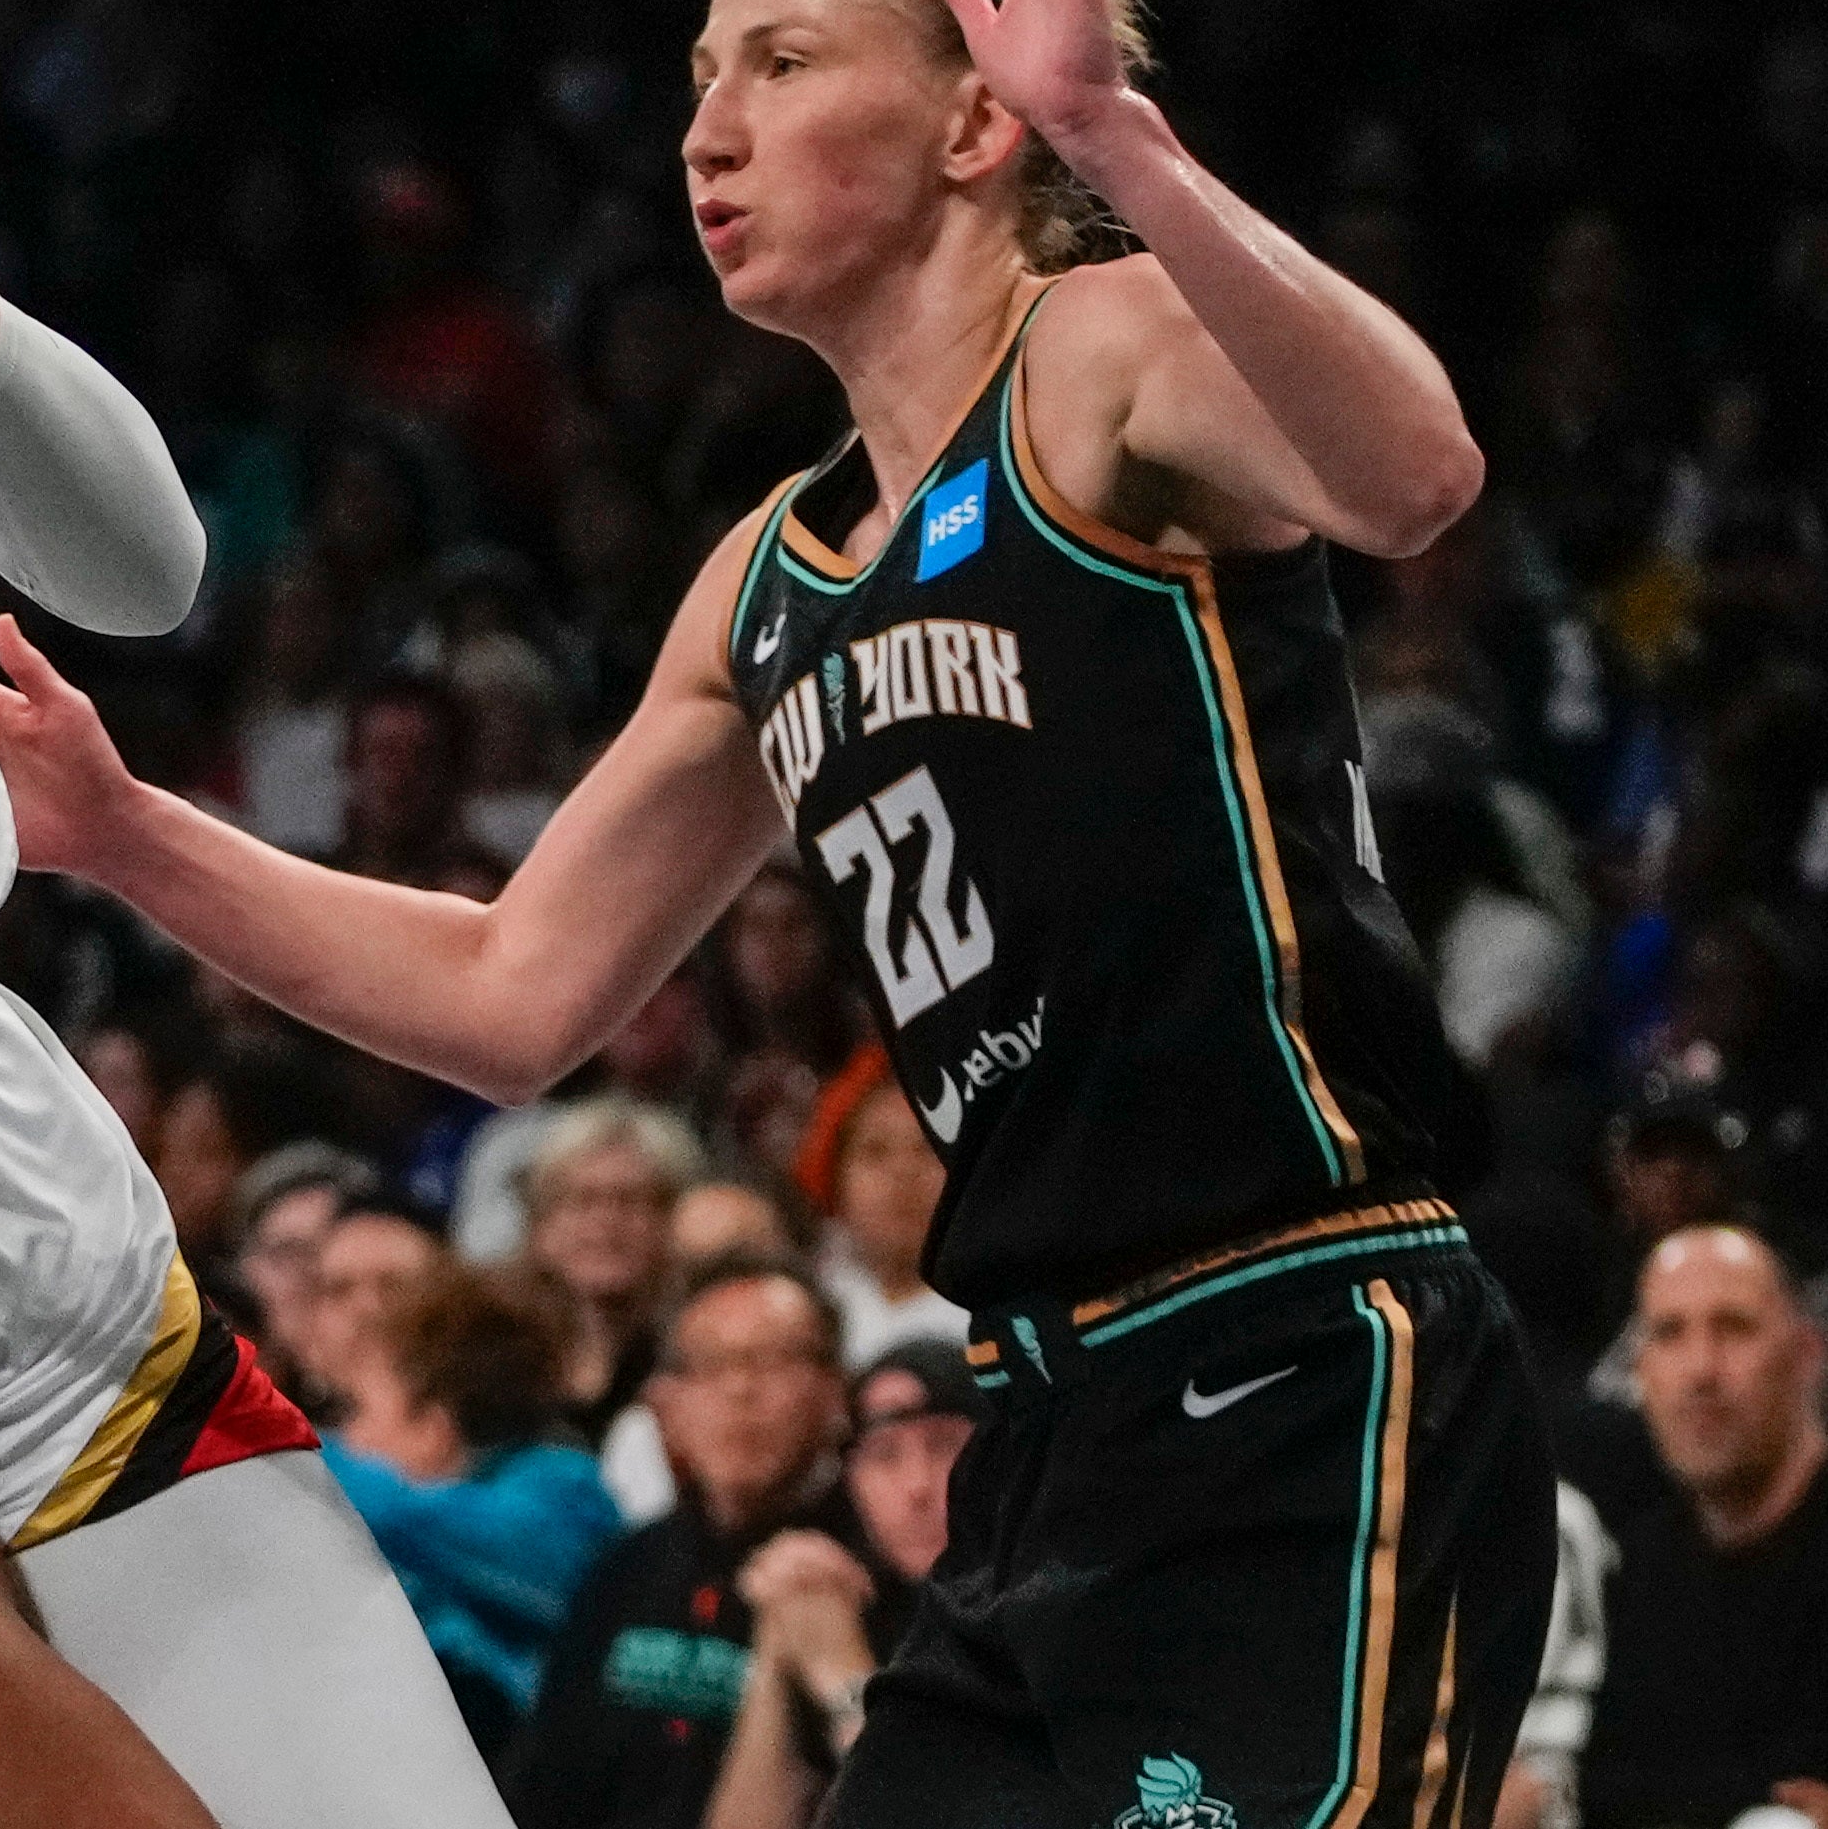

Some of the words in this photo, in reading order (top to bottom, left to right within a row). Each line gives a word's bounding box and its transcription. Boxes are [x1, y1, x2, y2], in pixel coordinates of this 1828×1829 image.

[927, 494, 979, 547] HSS
[849, 618, 1033, 735] YORK
[814, 764, 994, 1030] 22
